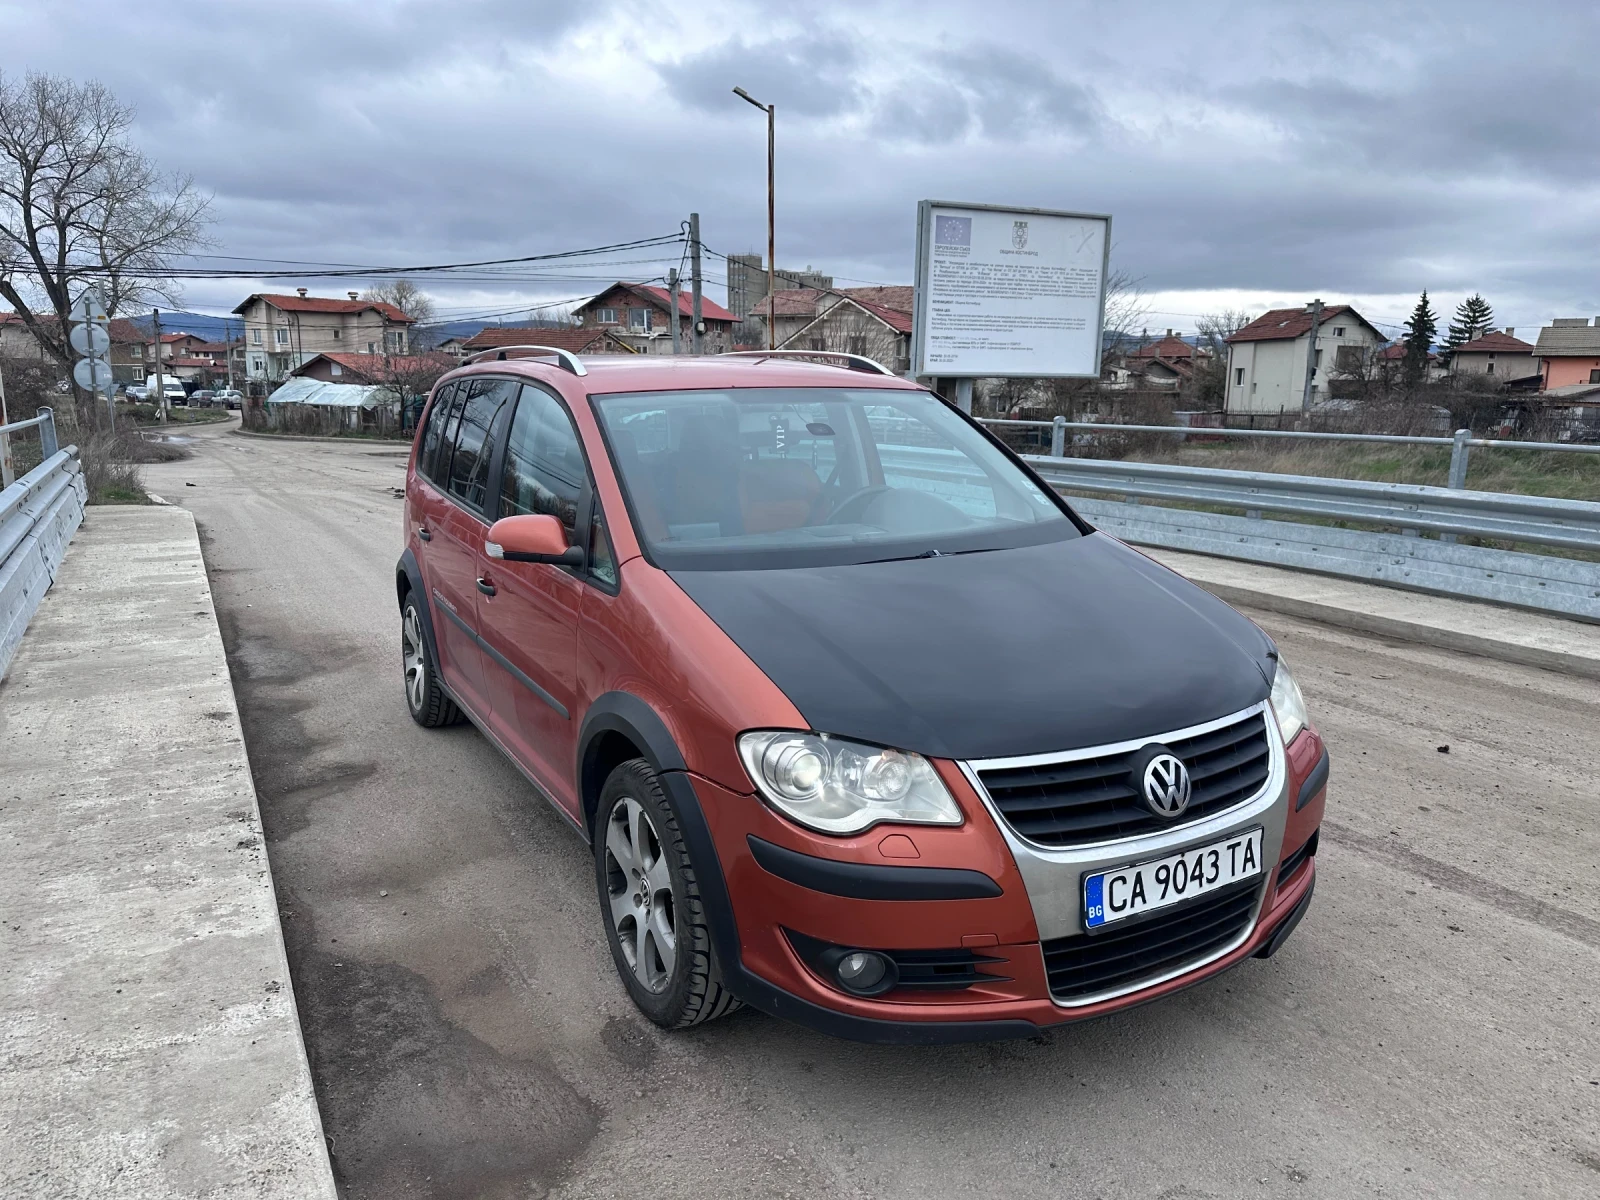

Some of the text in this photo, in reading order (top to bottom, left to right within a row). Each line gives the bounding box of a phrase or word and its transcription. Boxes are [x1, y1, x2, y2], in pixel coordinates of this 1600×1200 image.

[776, 425, 785, 449] VIP
[1109, 837, 1256, 912] CA 9043 TA
[1089, 905, 1102, 918] BG
